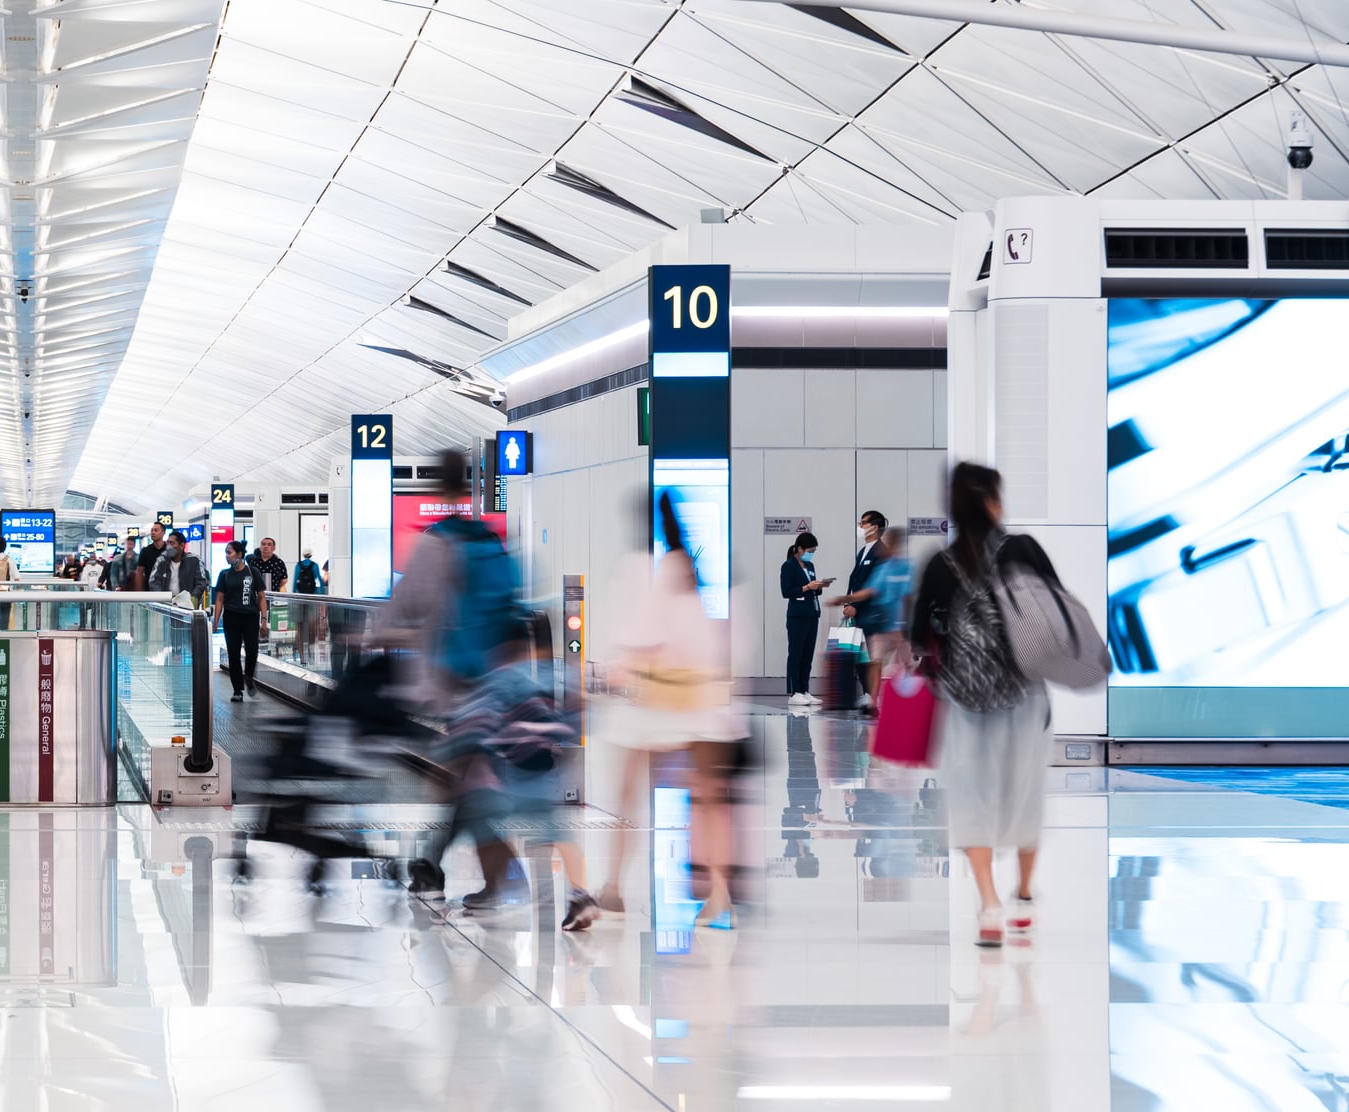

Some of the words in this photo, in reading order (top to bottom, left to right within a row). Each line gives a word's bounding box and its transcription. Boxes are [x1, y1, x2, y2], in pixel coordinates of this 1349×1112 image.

[664, 285, 718, 329] 10
[357, 424, 386, 448] 12
[213, 489, 232, 503] 24
[31, 518, 53, 527] 13-22
[242, 579, 251, 605] EAGLES
[41, 716, 51, 755] General
